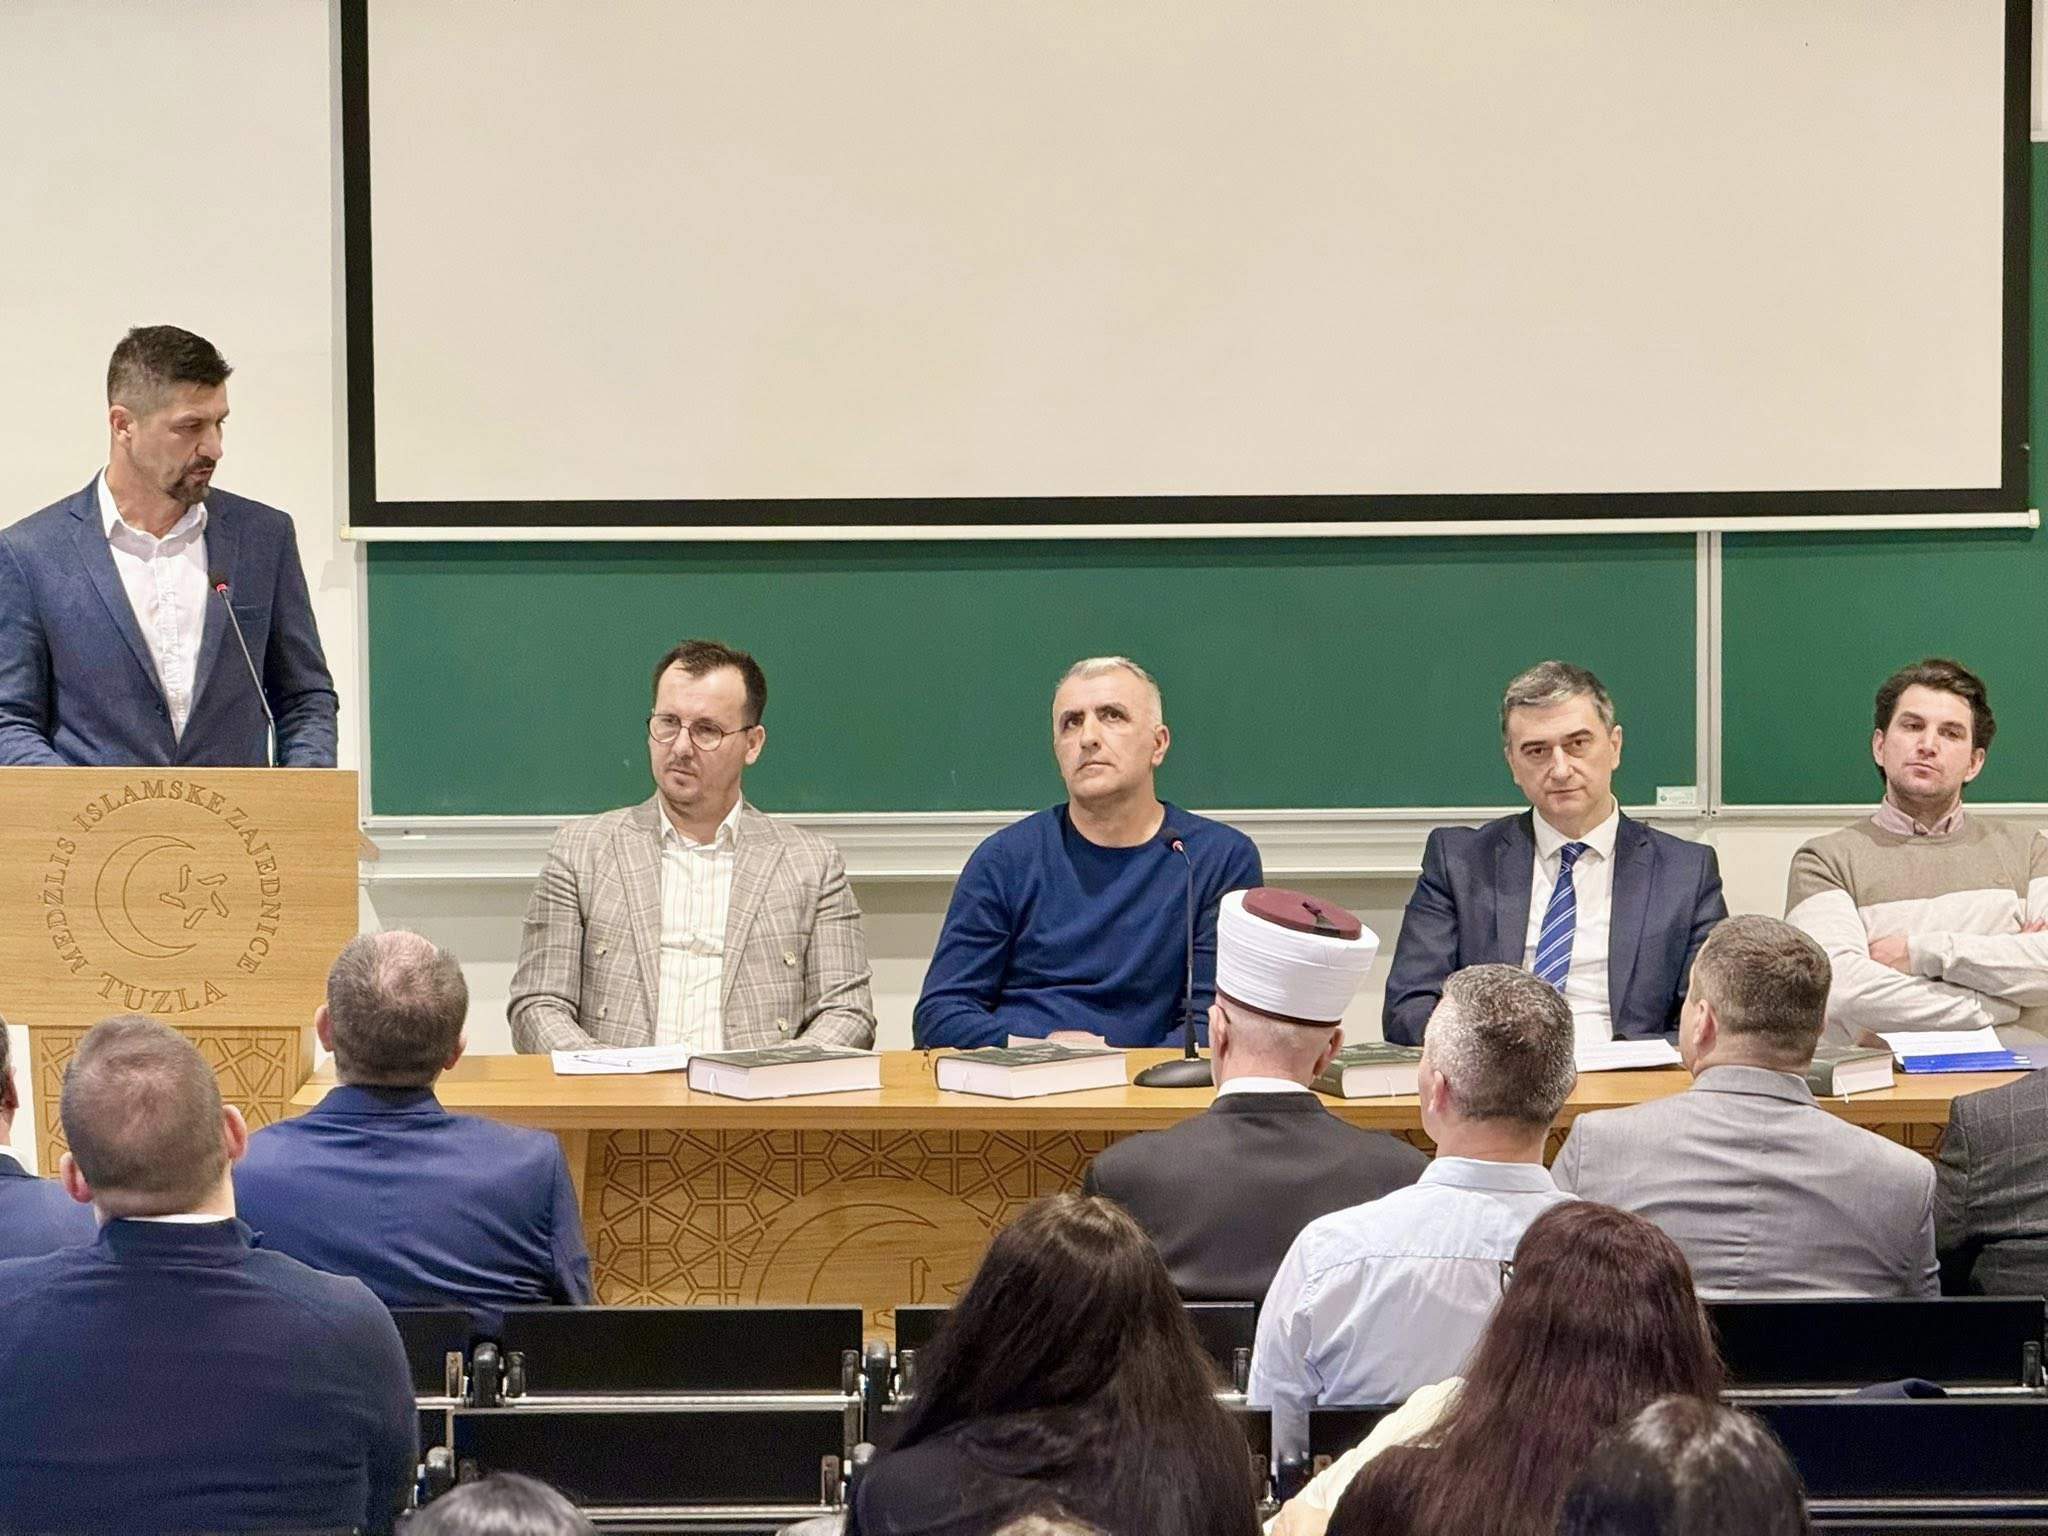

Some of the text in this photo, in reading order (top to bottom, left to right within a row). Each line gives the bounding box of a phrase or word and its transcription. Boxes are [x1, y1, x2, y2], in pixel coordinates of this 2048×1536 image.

[73, 779, 226, 832] ISLAMSKE
[225, 807, 281, 974] ZAJEDNICE
[97, 972, 228, 1014] TUZLA
